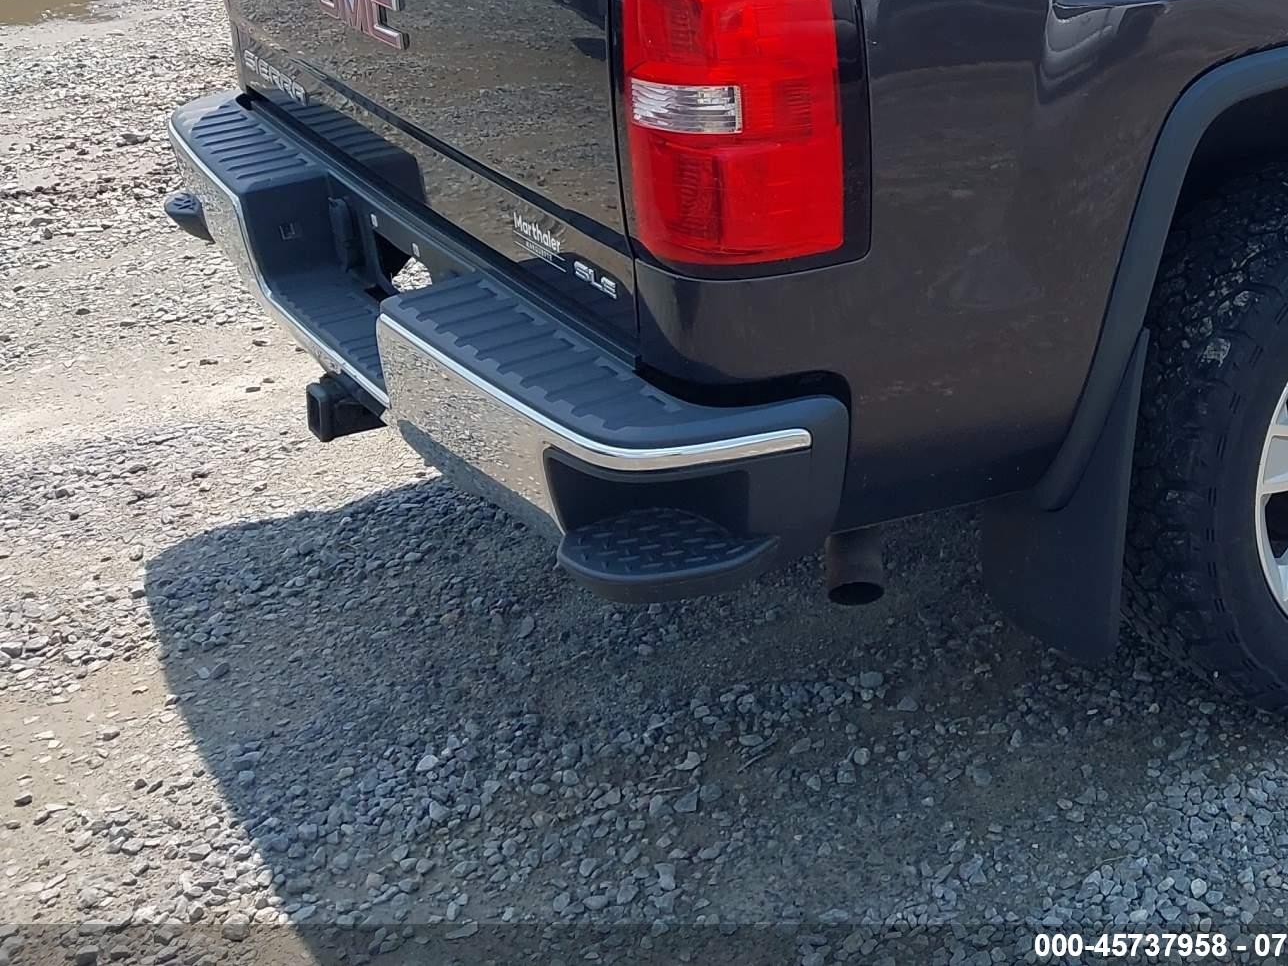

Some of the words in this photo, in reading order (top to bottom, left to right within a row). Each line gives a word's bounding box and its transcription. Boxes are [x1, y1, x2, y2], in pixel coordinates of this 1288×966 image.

[243, 49, 309, 107] SIERRA
[513, 211, 561, 253] Marthaler
[573, 260, 617, 300] SLE
